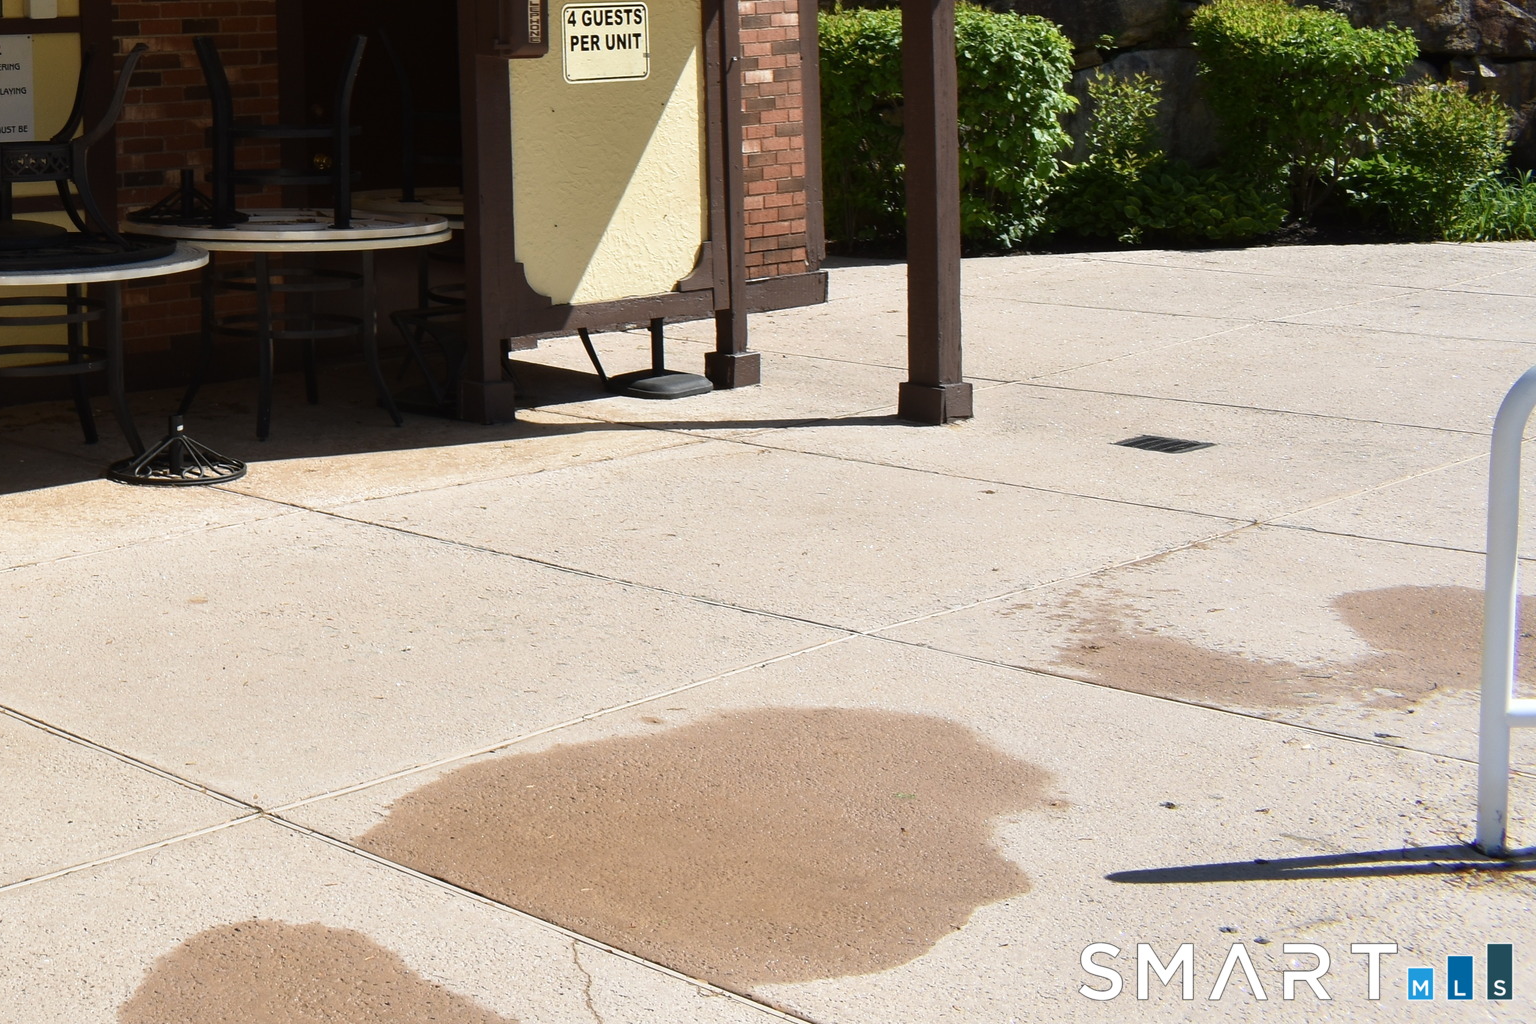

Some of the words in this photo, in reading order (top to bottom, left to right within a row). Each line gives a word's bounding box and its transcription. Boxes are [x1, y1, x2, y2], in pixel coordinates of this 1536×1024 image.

[567, 10, 577, 27] 4
[582, 8, 643, 27] GUESTS
[570, 34, 601, 52] PER
[605, 33, 642, 51] UNIT
[18, 124, 29, 133] BE
